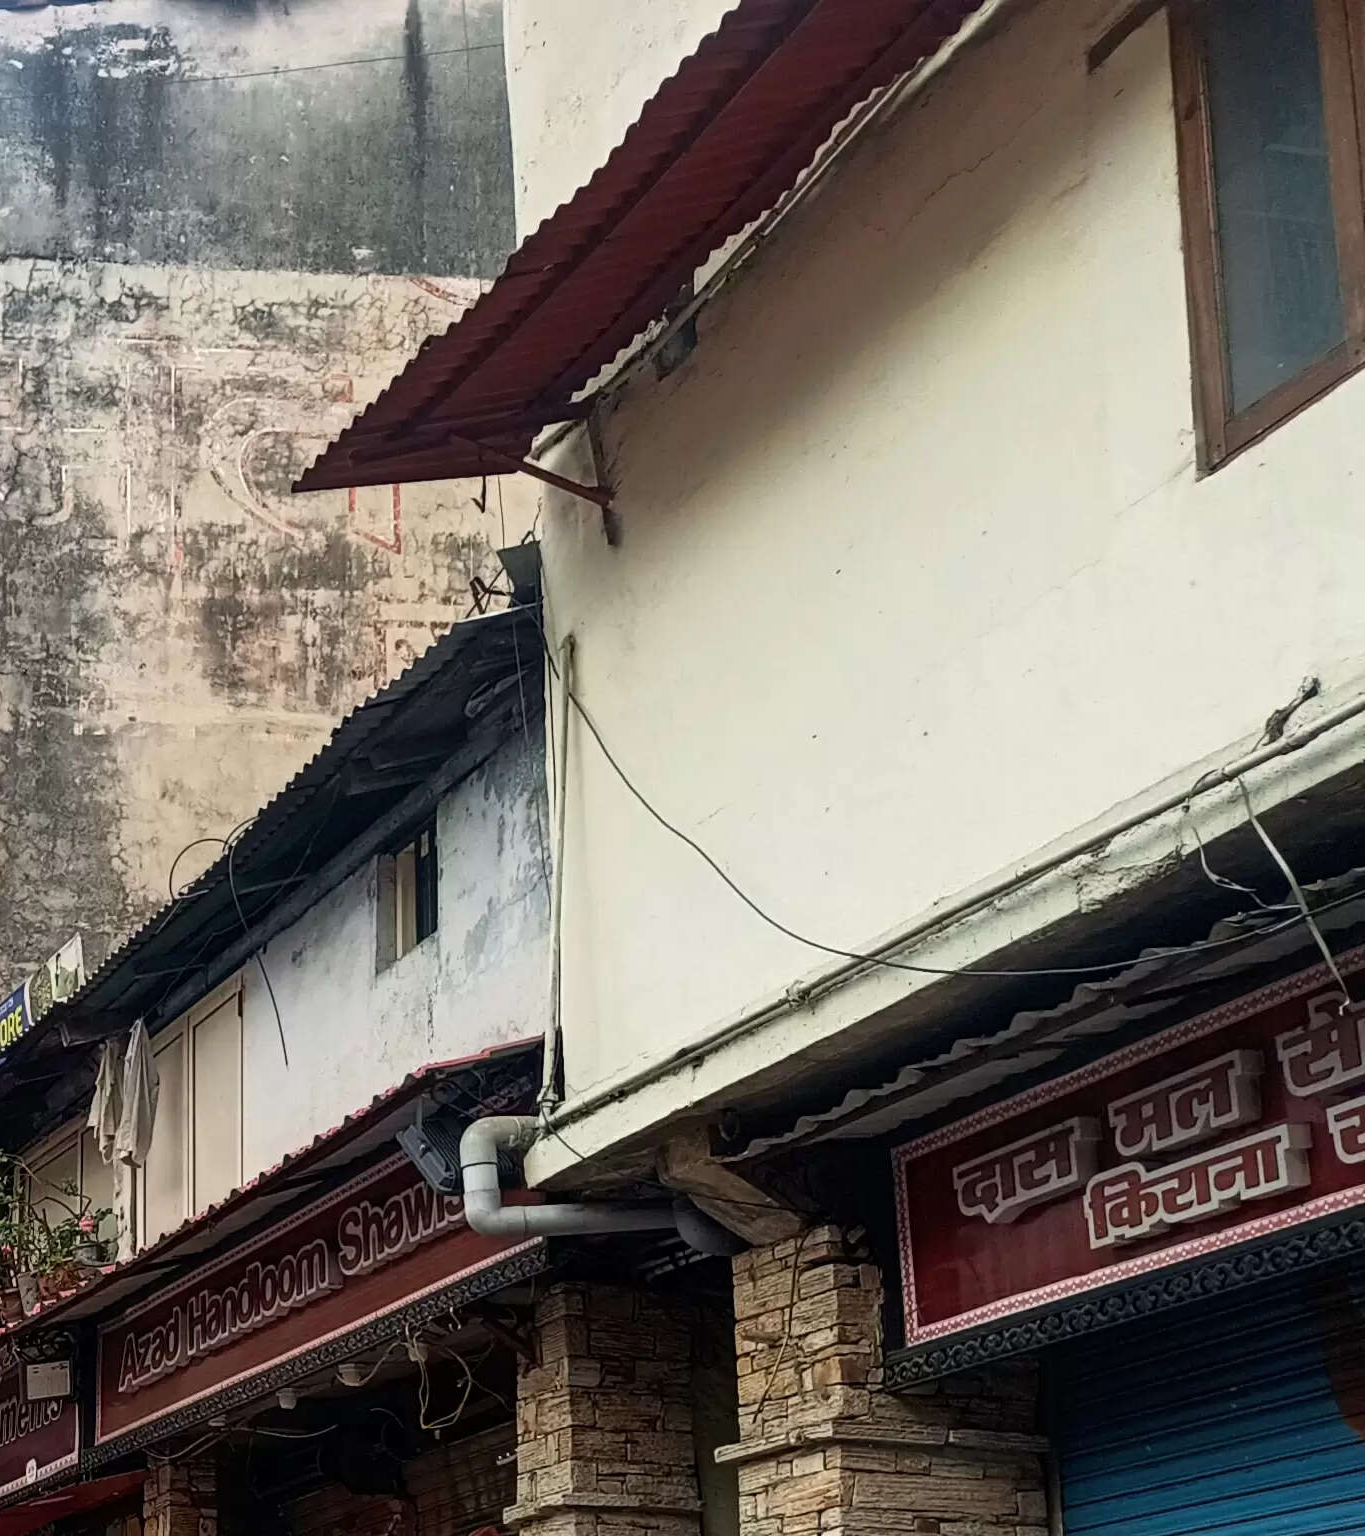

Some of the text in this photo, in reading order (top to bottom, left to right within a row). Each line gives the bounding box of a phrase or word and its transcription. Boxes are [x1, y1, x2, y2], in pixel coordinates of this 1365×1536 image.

[952, 1118, 1079, 1224] दास
[1107, 1049, 1245, 1157] मल
[1083, 1123, 1293, 1250] किराना
[118, 1305, 180, 1393] Azad
[186, 1238, 329, 1356] Handloom
